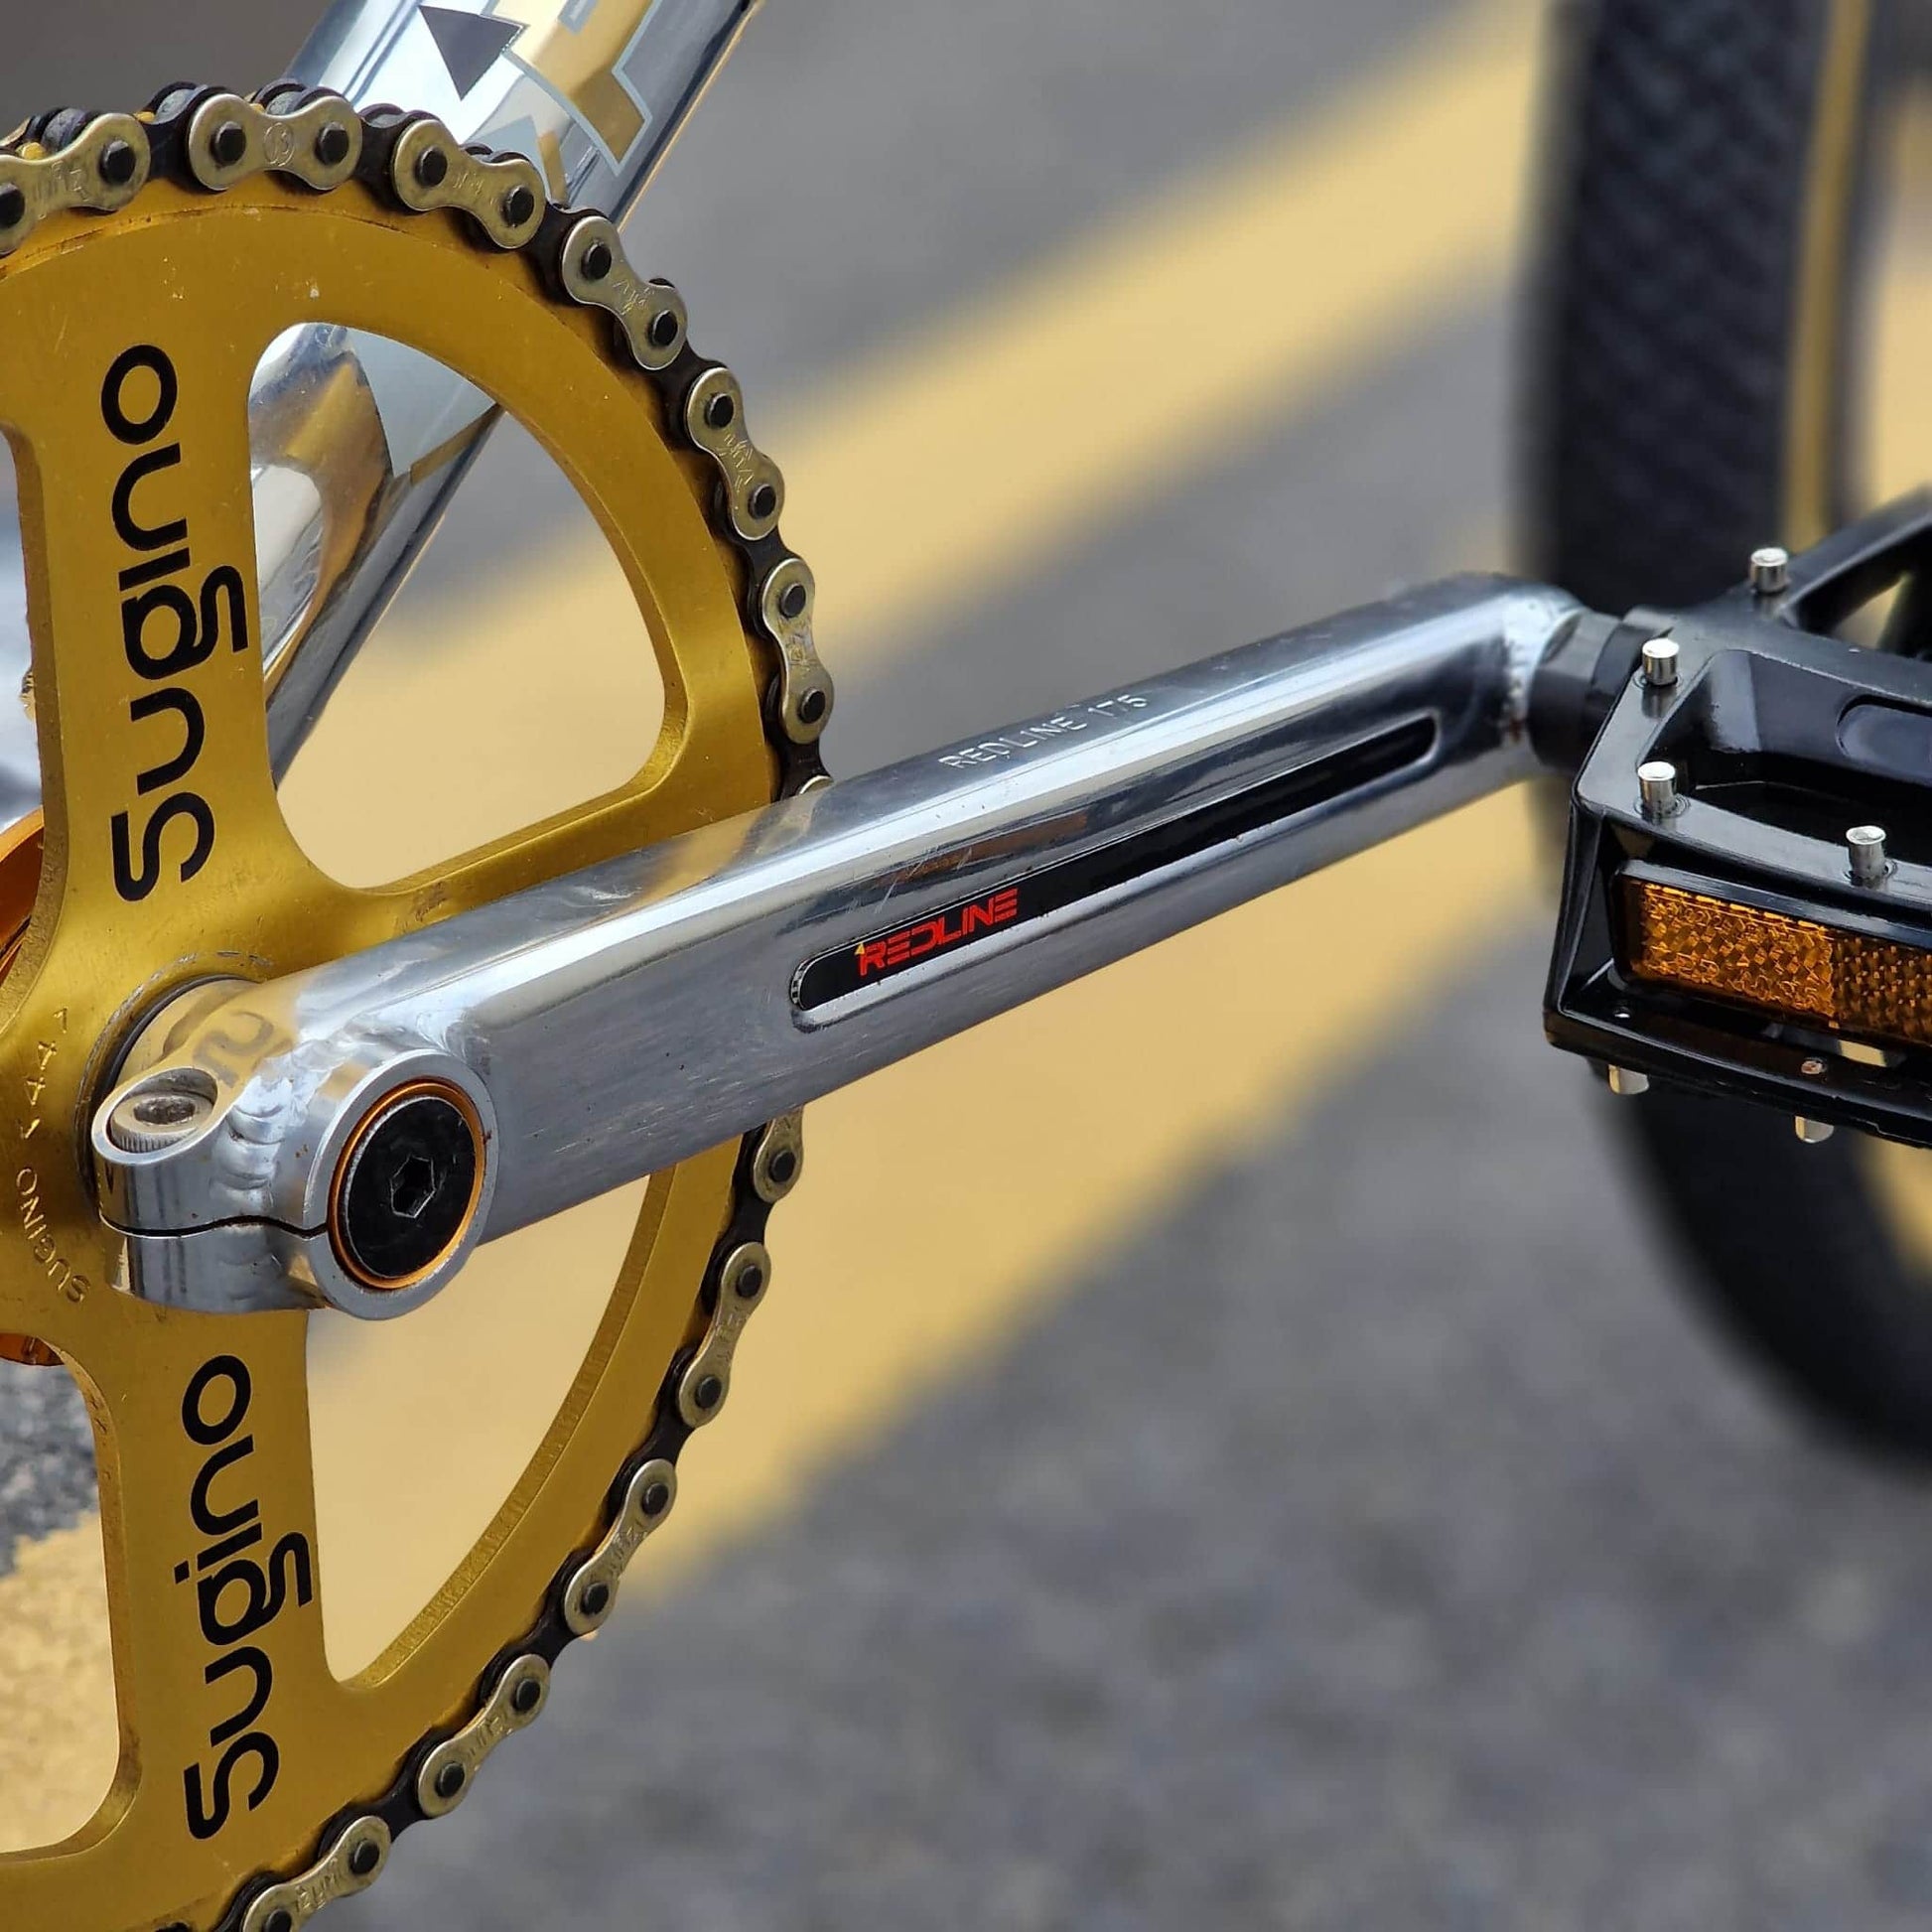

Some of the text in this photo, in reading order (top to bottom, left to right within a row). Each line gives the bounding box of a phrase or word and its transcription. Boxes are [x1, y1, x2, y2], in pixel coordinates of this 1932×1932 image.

[938, 694, 1148, 769] REDLINE 175
[856, 888, 1019, 977] REDLINE
[16, 1168, 91, 1304] SUGINO
[174, 1354, 313, 1840] Sugino
